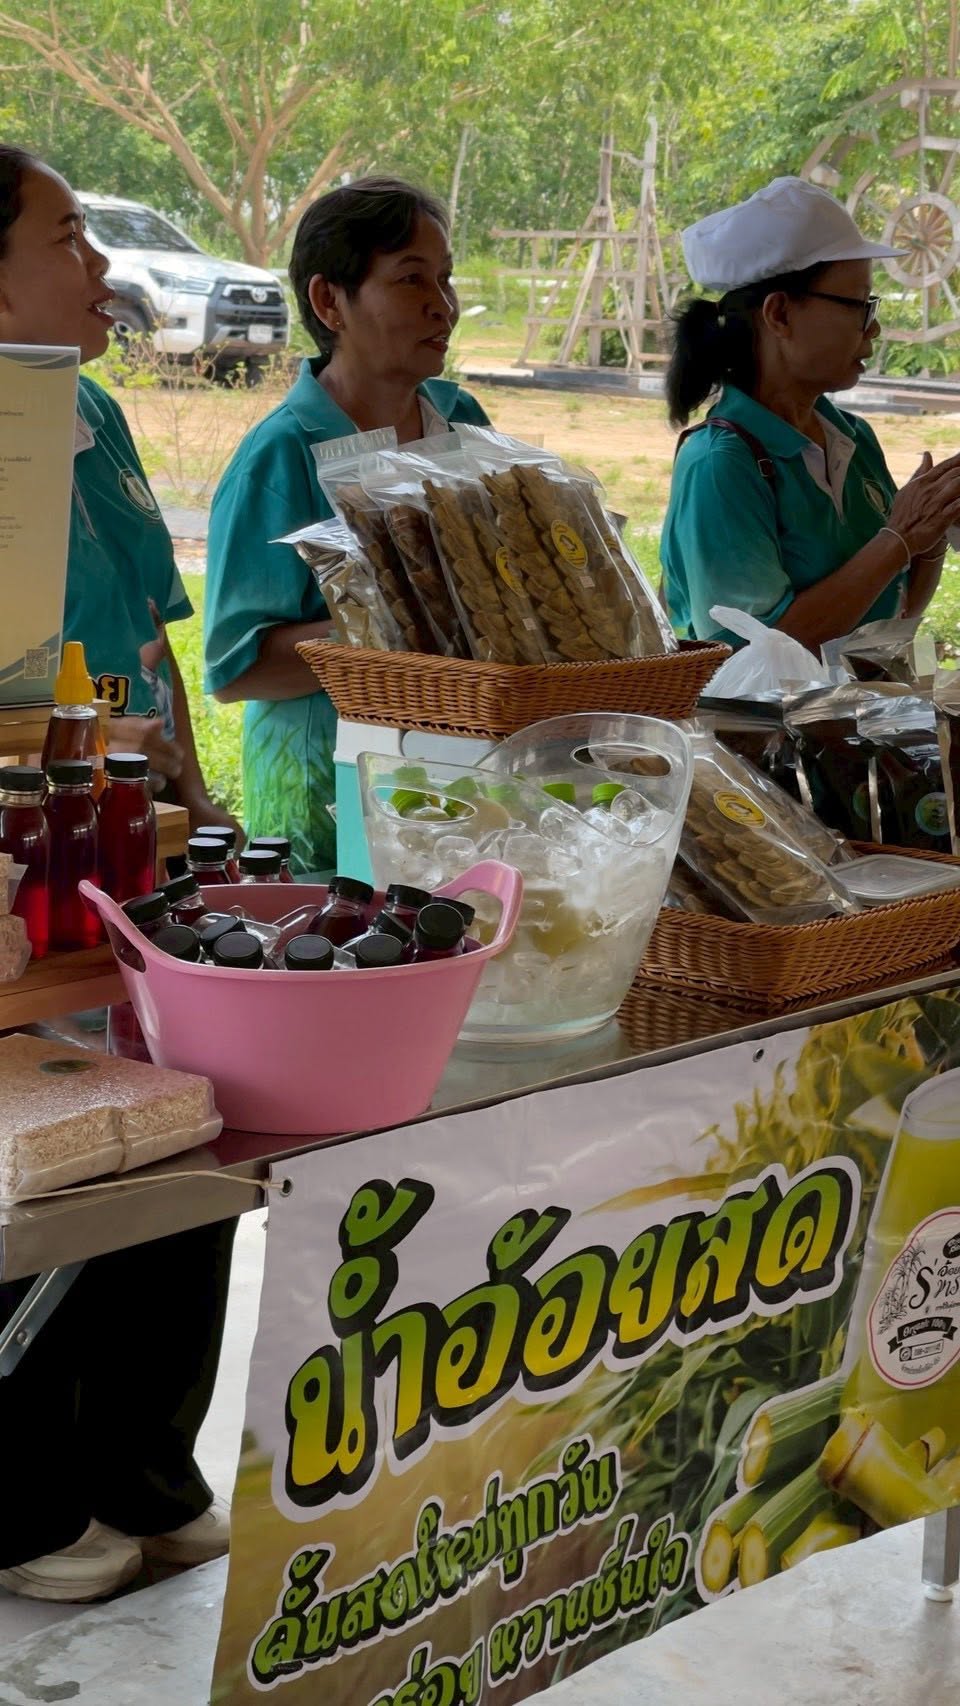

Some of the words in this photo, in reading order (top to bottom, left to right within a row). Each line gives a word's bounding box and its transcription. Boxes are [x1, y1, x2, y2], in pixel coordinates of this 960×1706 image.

[285, 1168, 851, 1509] น้ำอ้อยสด
[252, 1438, 618, 1684] คั้นสดใหม่ทุกวัน
[368, 1641, 484, 1706] ร่อย
[490, 1517, 689, 1677] หวานชื่นใจ
